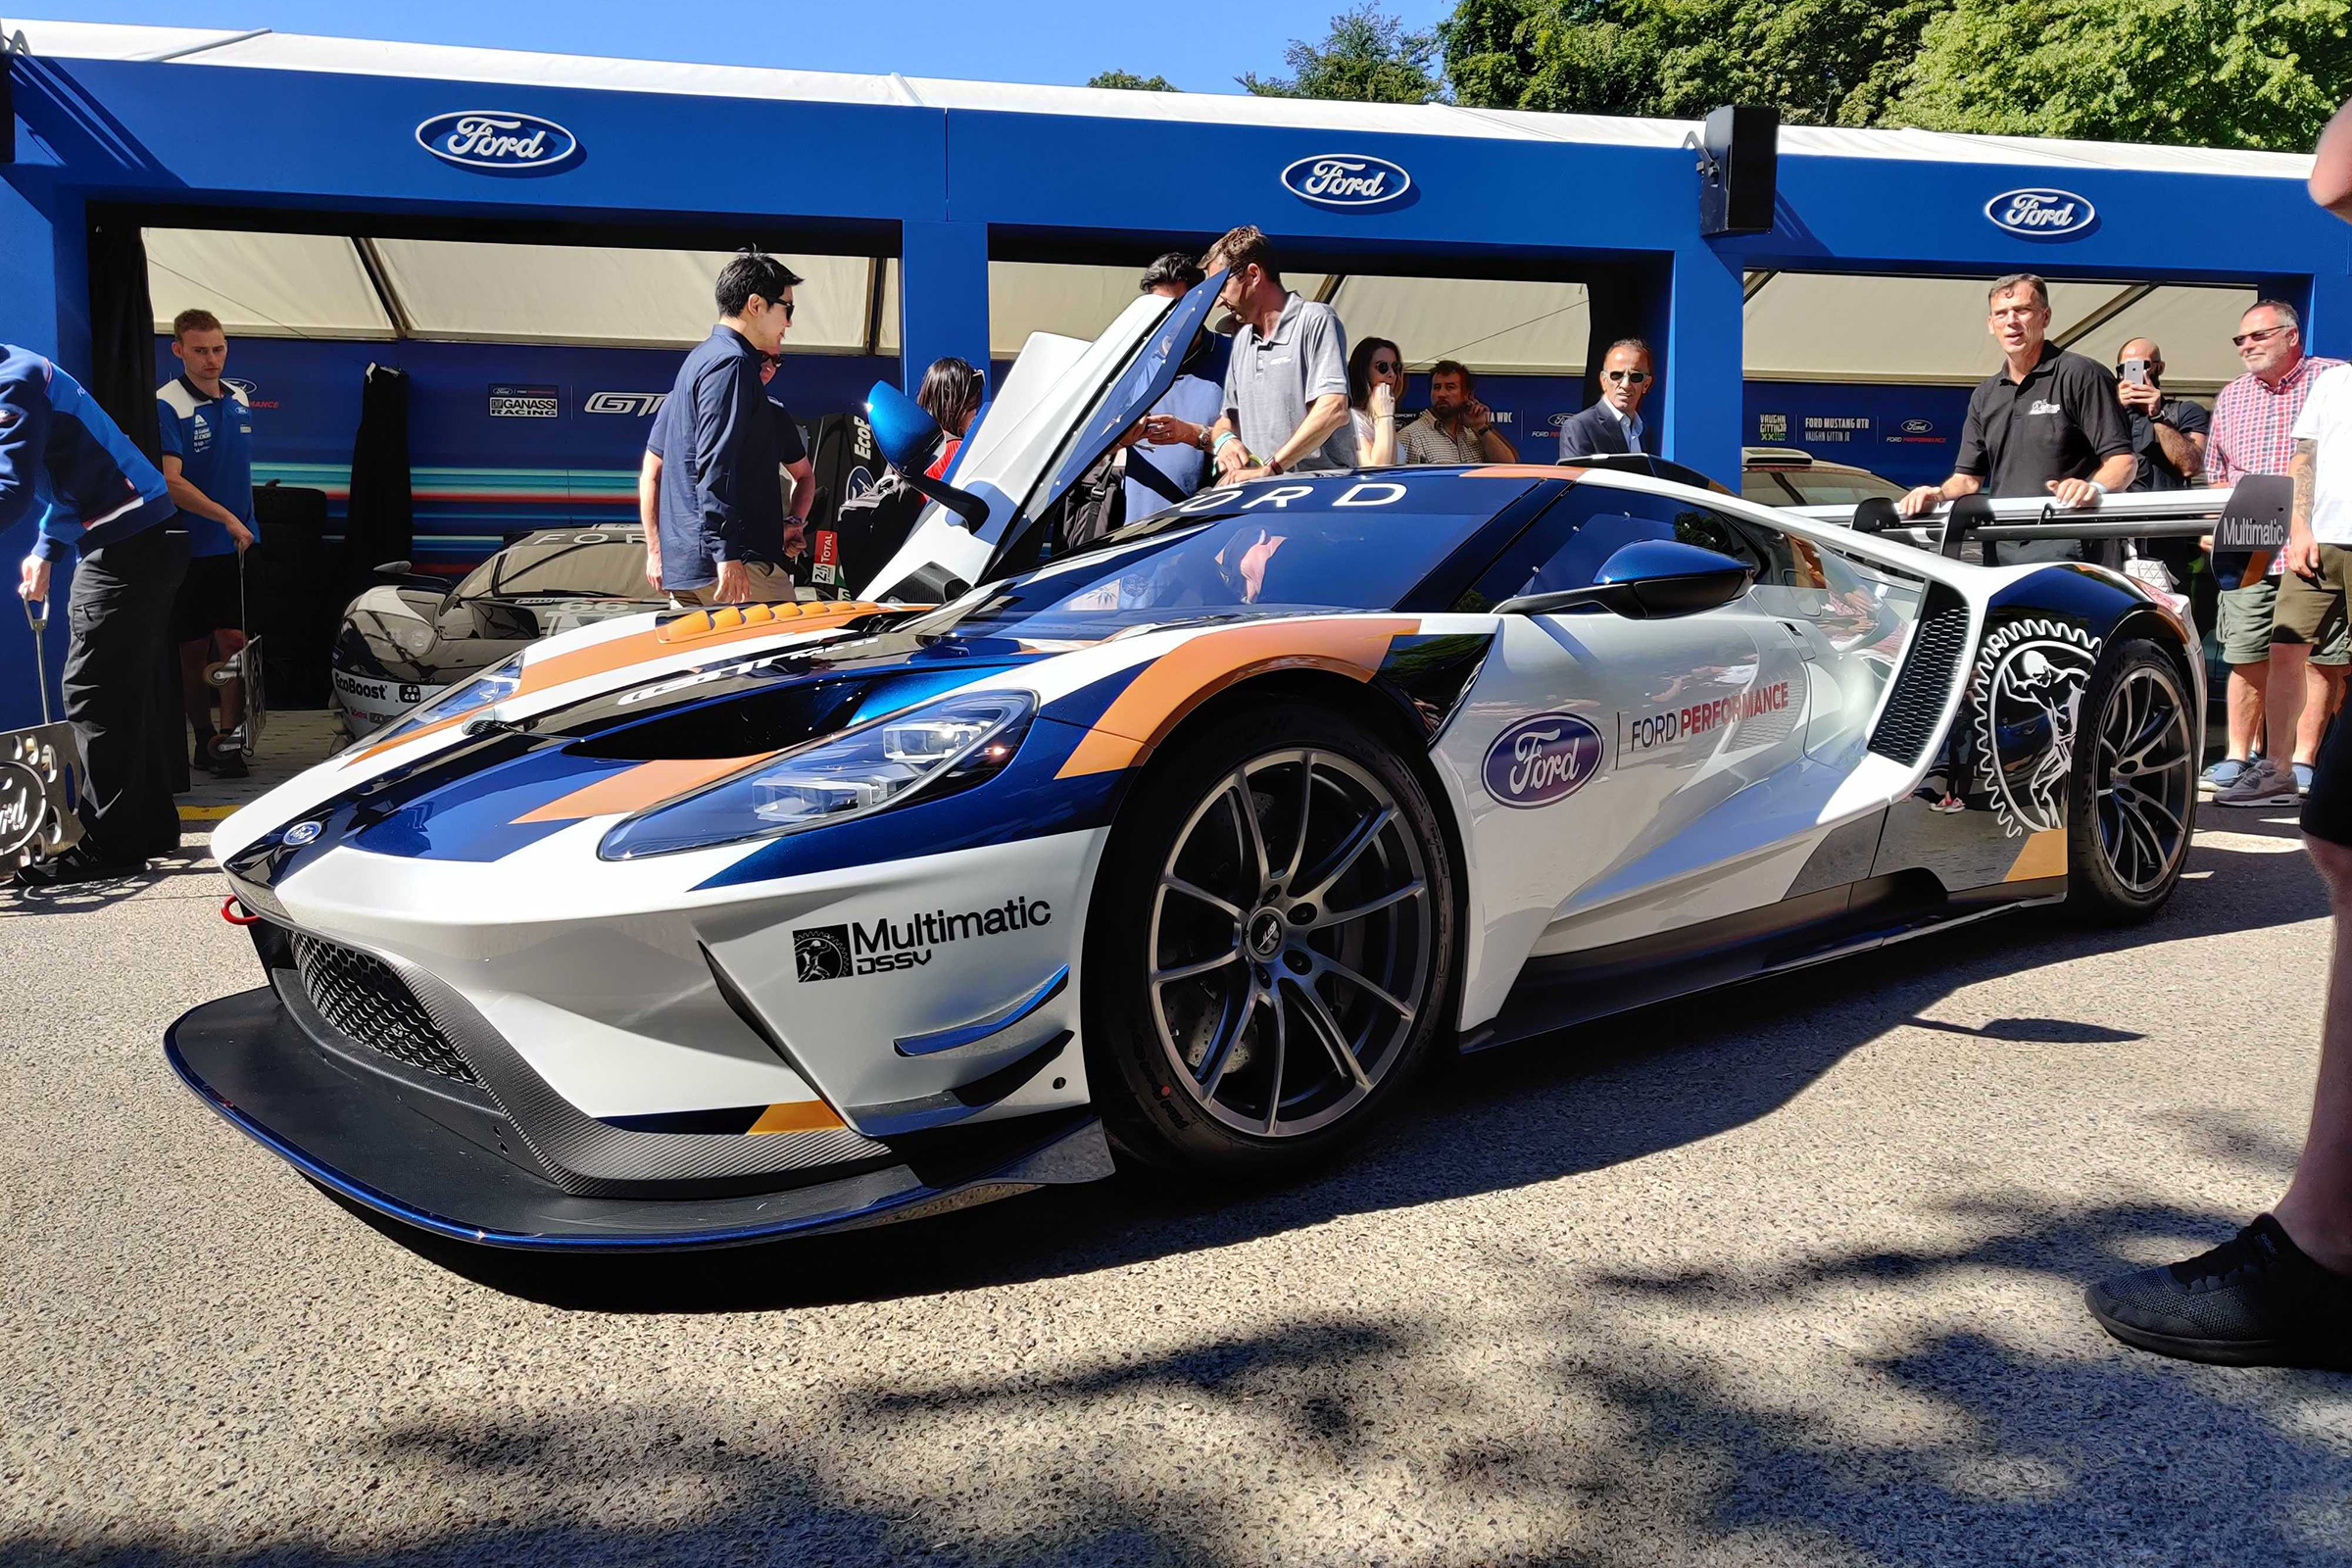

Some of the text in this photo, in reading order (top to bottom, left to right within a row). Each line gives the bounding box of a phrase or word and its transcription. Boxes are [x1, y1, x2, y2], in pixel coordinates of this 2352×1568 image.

[447, 117, 546, 159] Ford
[1305, 160, 1386, 197] Ford
[2006, 193, 2075, 226] Ford
[503, 399, 556, 410] GANASSI
[584, 391, 668, 417] GT
[1496, 412, 1513, 423] WRC
[1804, 431, 1826, 442] VAUGHN
[1805, 417, 1823, 428] FORD
[1824, 417, 1855, 429] MUSTANG
[1906, 421, 1928, 431] Ford
[1179, 482, 1407, 513] ORD
[532, 532, 647, 545] FOR
[2222, 516, 2284, 547] Multimatic
[820, 533, 833, 564] TOTAL
[334, 671, 386, 701] EcoBoost
[1631, 681, 1789, 753] FORD PERFORMANCE
[1509, 728, 1582, 795] Ford
[854, 896, 1052, 956] Multimatic
[857, 949, 932, 976] DSSV
